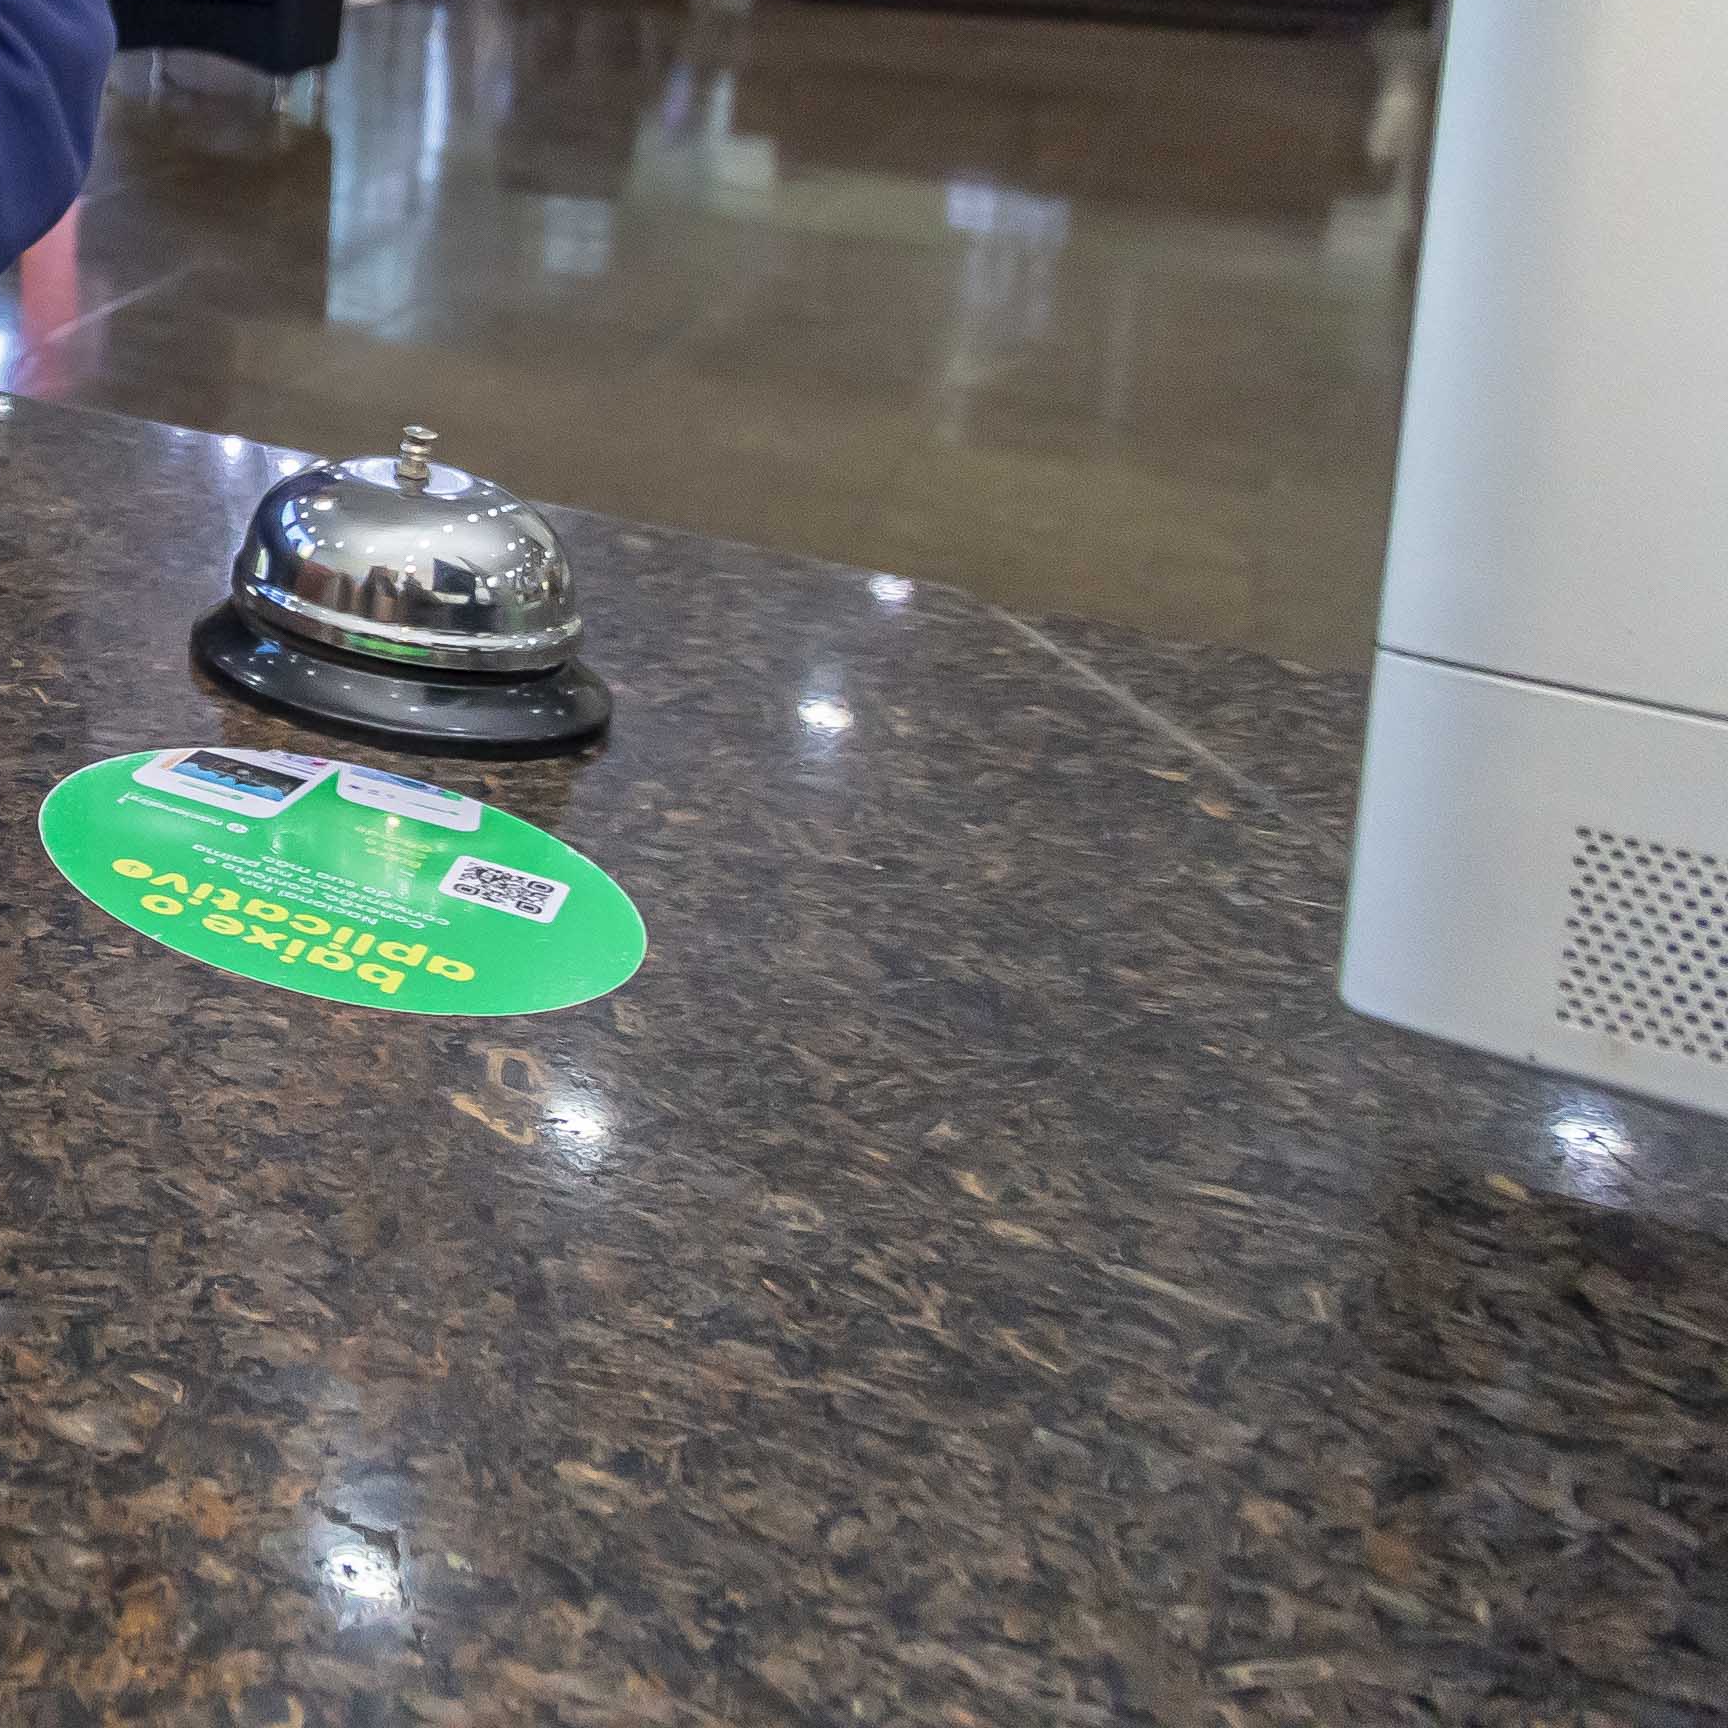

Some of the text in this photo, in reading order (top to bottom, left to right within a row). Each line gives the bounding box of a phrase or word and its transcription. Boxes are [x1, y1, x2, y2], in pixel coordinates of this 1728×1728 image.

[192, 843, 261, 869] palma
[111, 857, 476, 982] aplicativo
[277, 888, 379, 925] Nacional
[139, 893, 407, 995] baixe o
